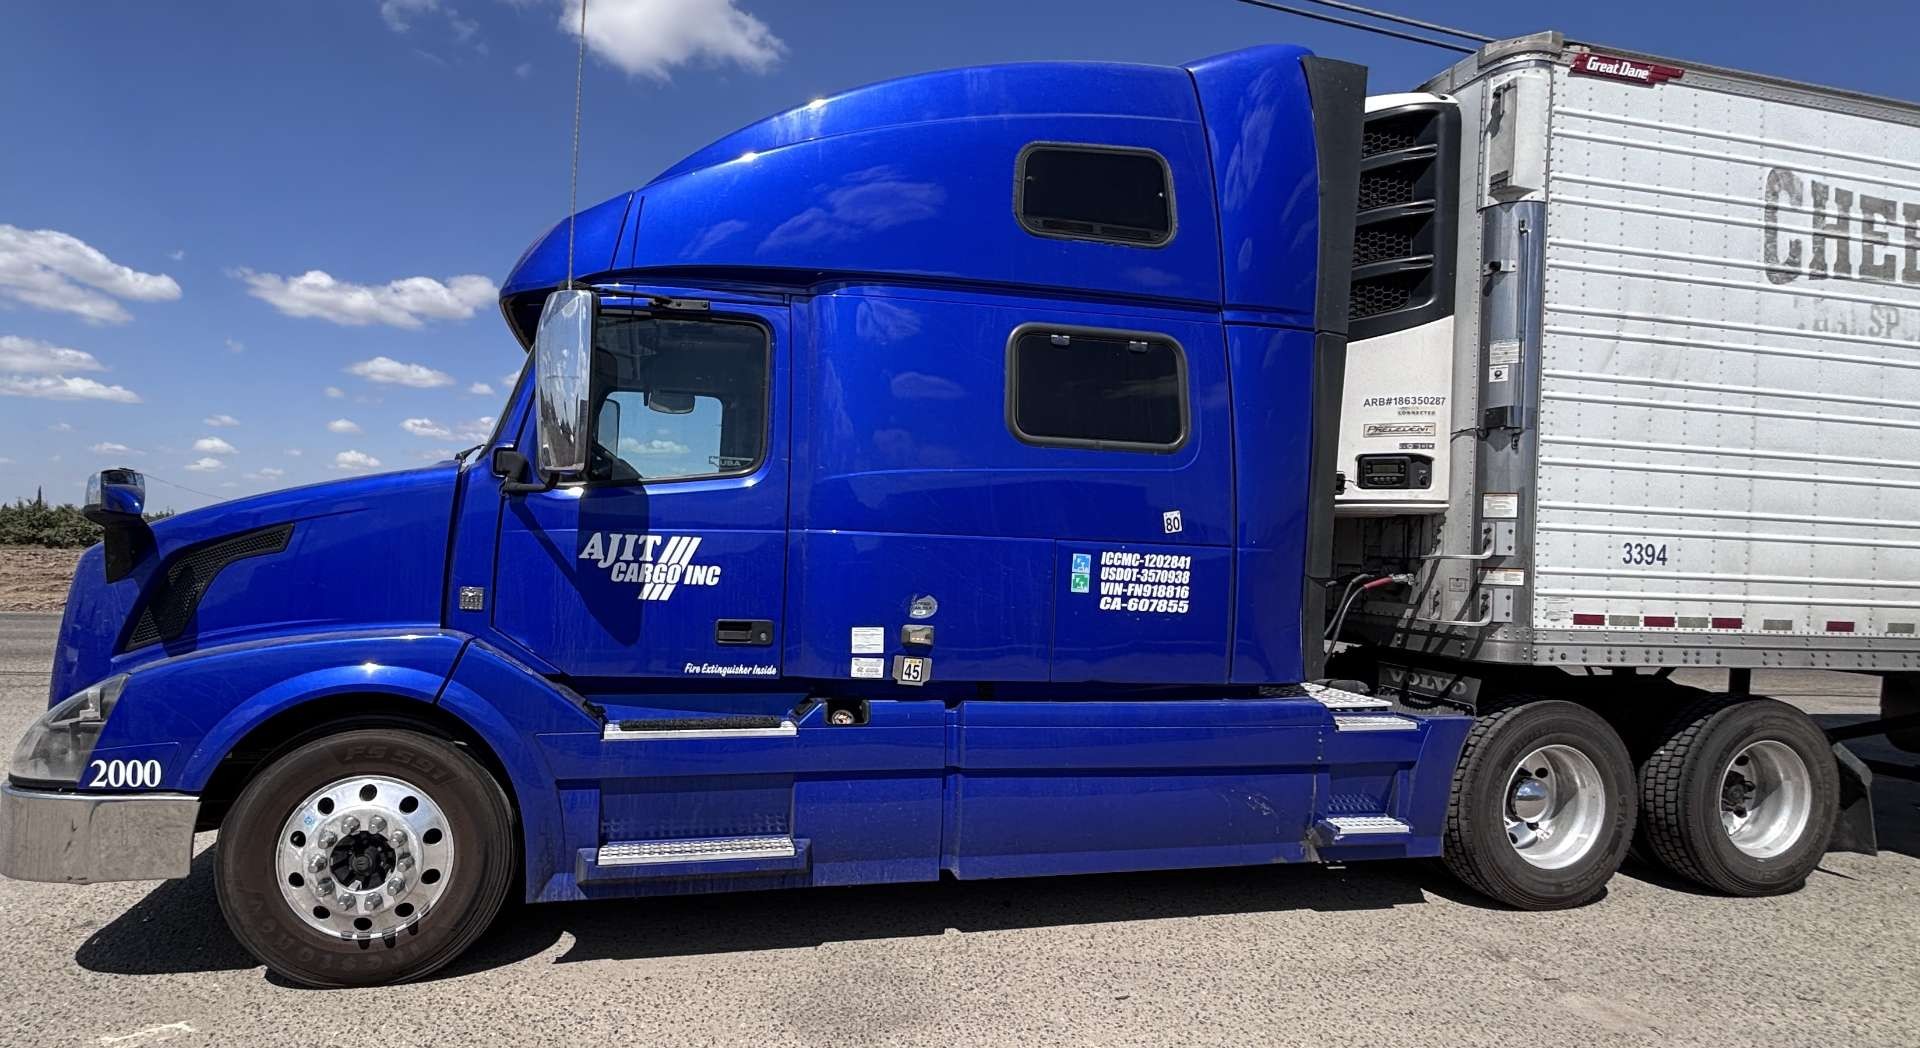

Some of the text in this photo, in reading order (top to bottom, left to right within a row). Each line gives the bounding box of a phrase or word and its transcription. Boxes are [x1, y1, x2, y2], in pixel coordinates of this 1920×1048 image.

[1586, 56, 1649, 80] Great Dane
[1363, 396, 1446, 408] ARB#186350287
[1166, 516, 1180, 532] 80
[578, 532, 662, 569] AJIT
[1622, 542, 1668, 566] 3394
[1101, 551, 1191, 570] ICCMC-1202841
[610, 561, 721, 586] CARGO INC
[1100, 566, 1191, 584] USDOT-3570938
[1100, 582, 1190, 599] VIN-FN918816
[1099, 597, 1189, 614] CA-607855
[684, 662, 777, 677] Fire Extinguisher Inside
[904, 663, 920, 680] 45
[88, 759, 162, 788] 2000
